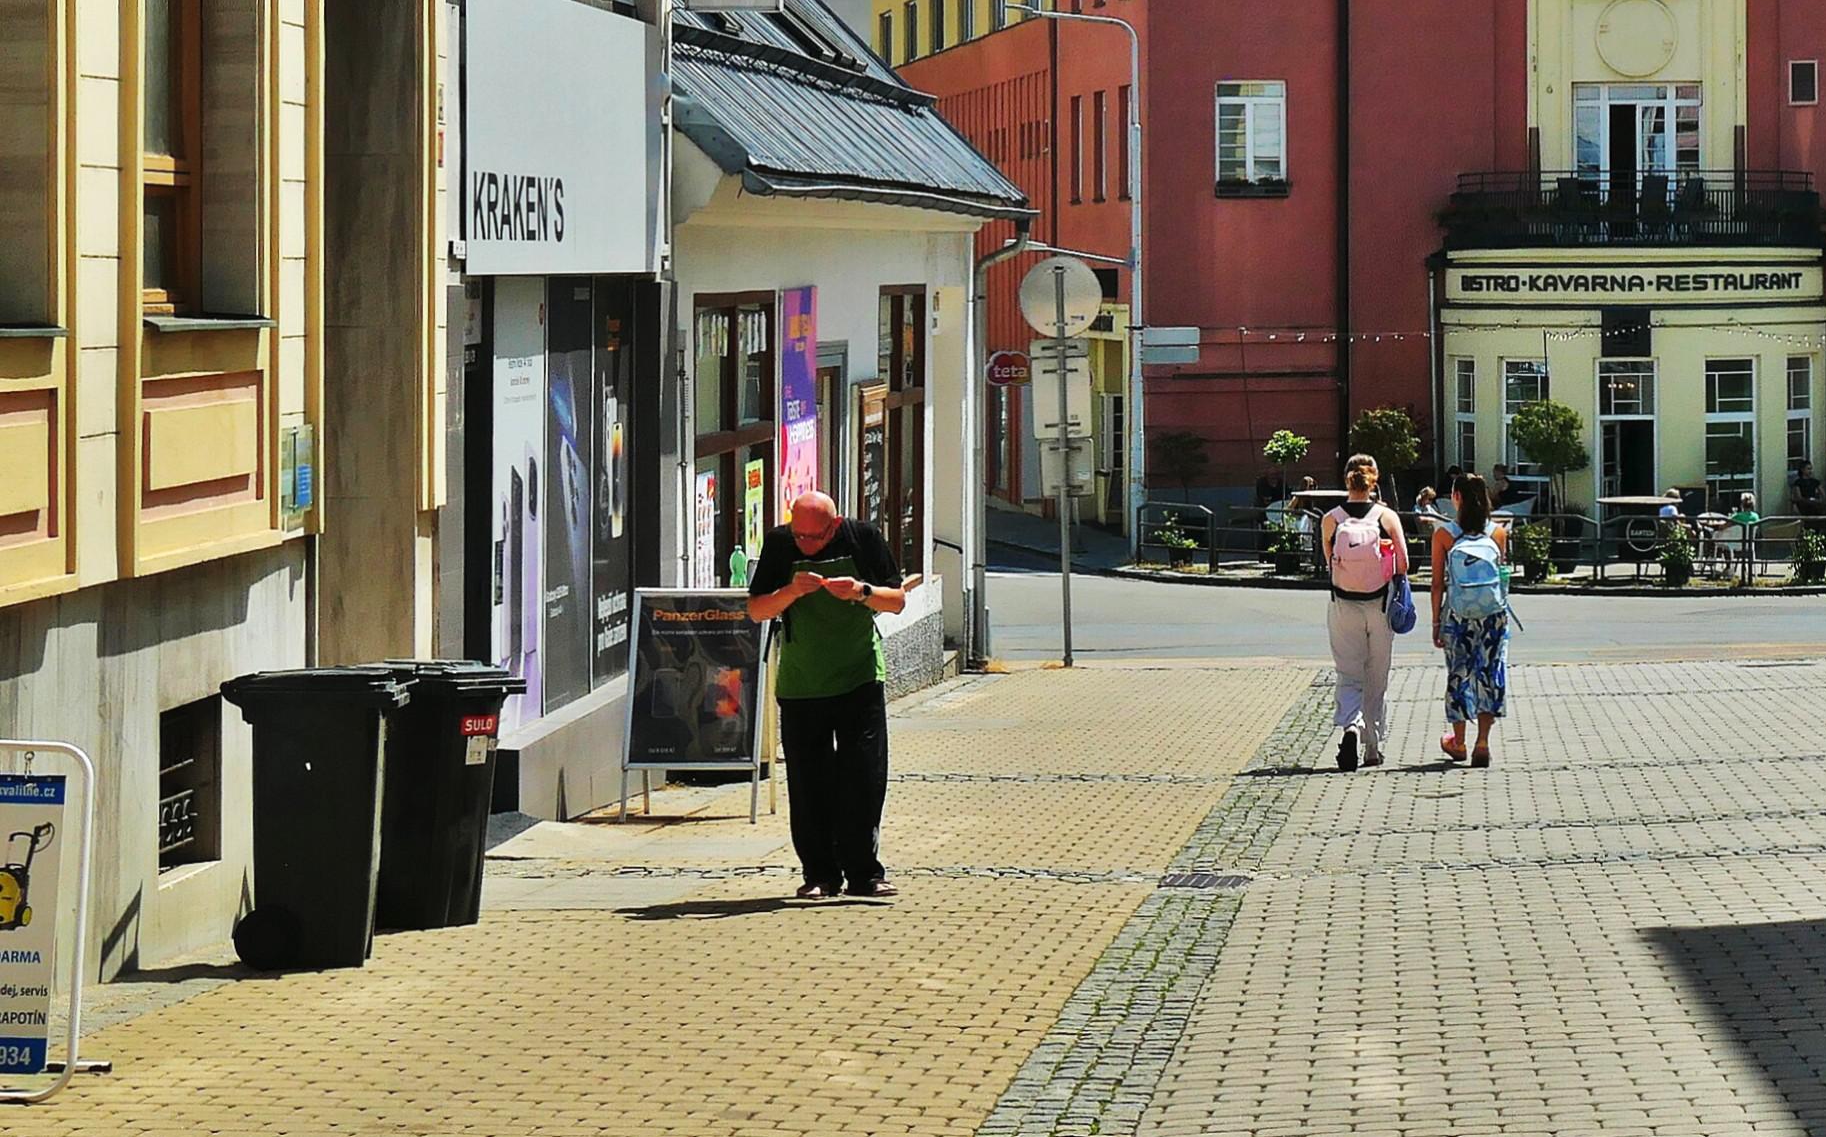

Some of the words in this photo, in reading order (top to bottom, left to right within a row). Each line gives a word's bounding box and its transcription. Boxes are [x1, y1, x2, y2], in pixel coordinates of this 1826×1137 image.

[473, 171, 566, 243] KRAKEN'S
[1655, 272, 1803, 292] RESTAURANT
[993, 364, 1029, 378] teta
[652, 609, 746, 622] PanzerGlass
[465, 718, 493, 732] SULO
[0, 950, 41, 964] ARMA
[20, 984, 49, 997] servis
[0, 1009, 47, 1025] APOTÍN
